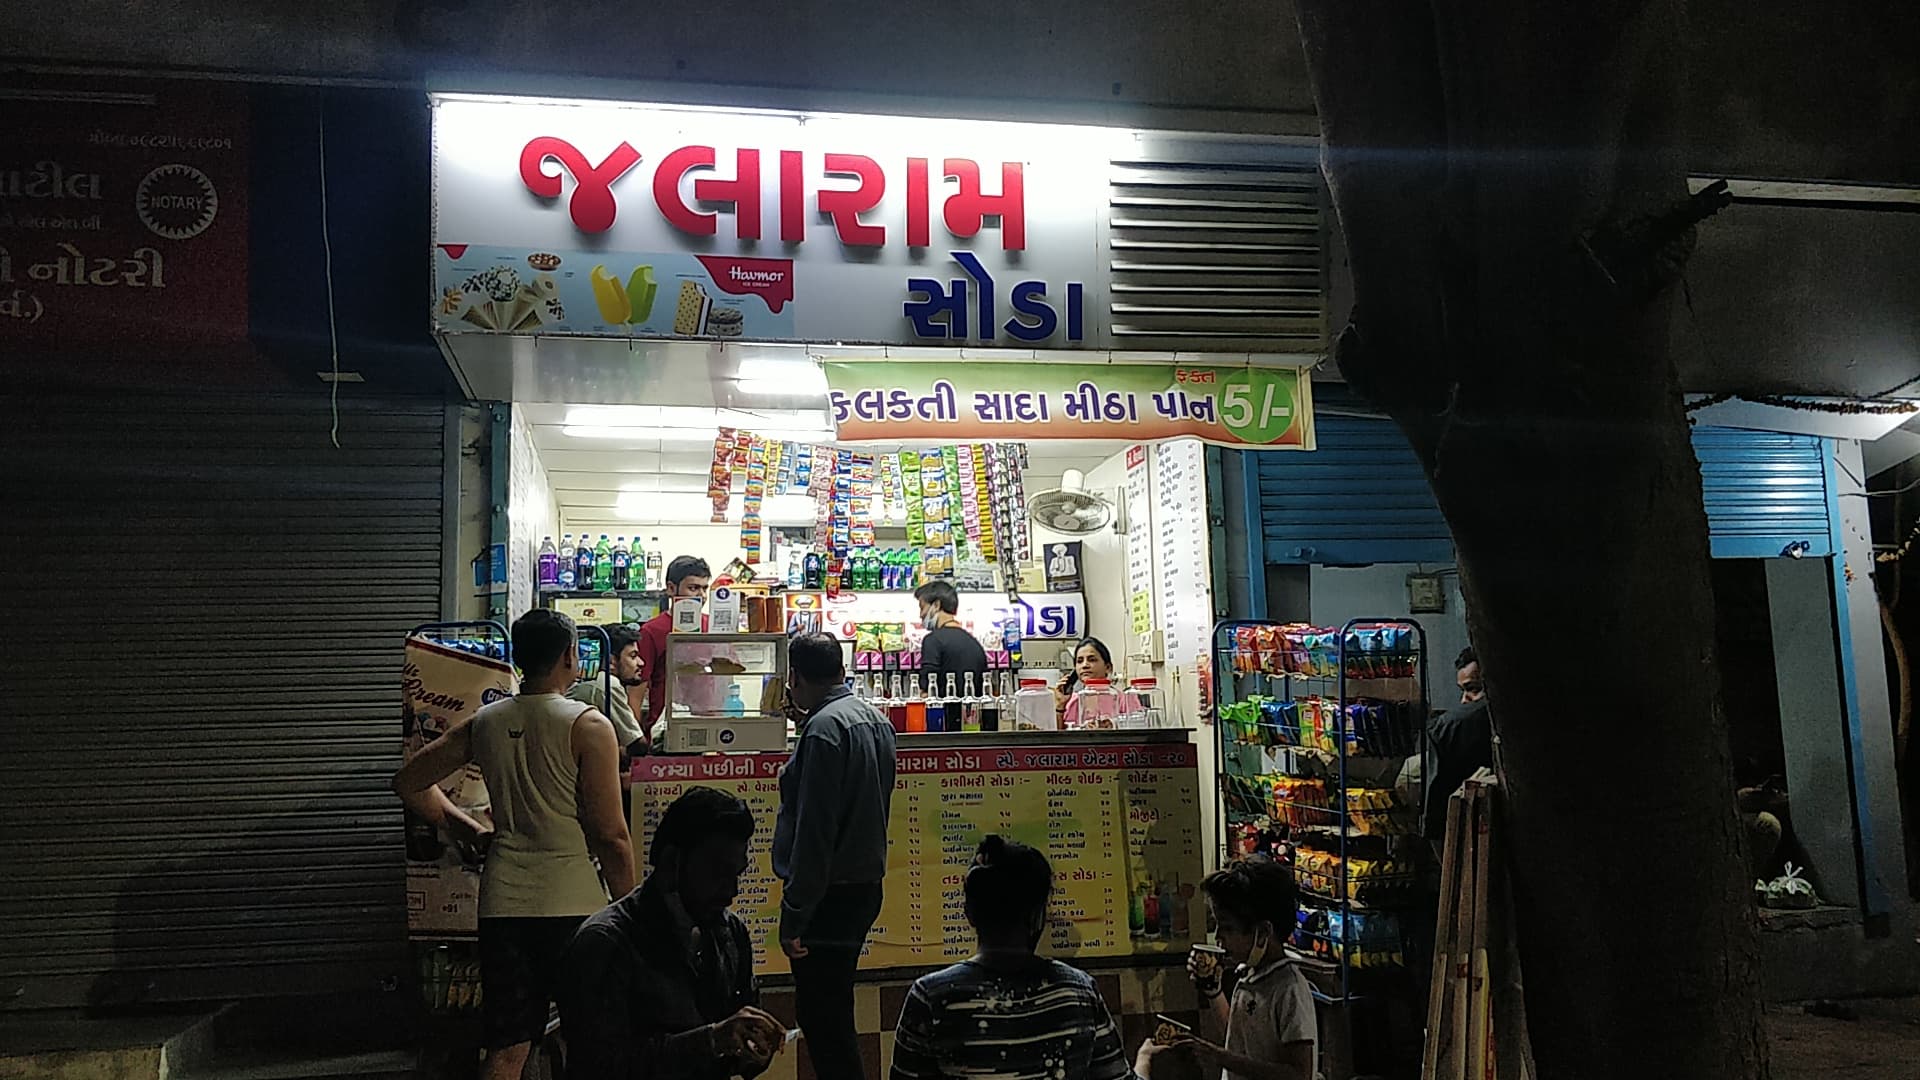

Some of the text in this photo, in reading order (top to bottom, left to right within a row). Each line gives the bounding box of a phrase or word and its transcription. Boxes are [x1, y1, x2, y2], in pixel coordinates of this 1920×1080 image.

[151, 197, 203, 210] NOTARY
[519, 136, 1027, 251] જલારામ
[27, 242, 166, 288] નોટરી
[729, 265, 784, 282] Havmor
[903, 251, 1083, 342] સોડા
[974, 391, 1047, 423] સાદા
[1064, 381, 1138, 423] મીઠા
[1153, 391, 1215, 422] પાન
[1223, 383, 1290, 429] 5/-
[651, 764, 694, 778] જમ્યા
[702, 758, 754, 775] પછીની
[896, 752, 980, 771] લારામ સોડા
[1025, 754, 1077, 768] જલારામ
[1083, 748, 1118, 765] એટમ
[1123, 748, 1153, 765] સોડા
[990, 774, 1015, 787] સોડા
[1073, 867, 1097, 881] સોડા
